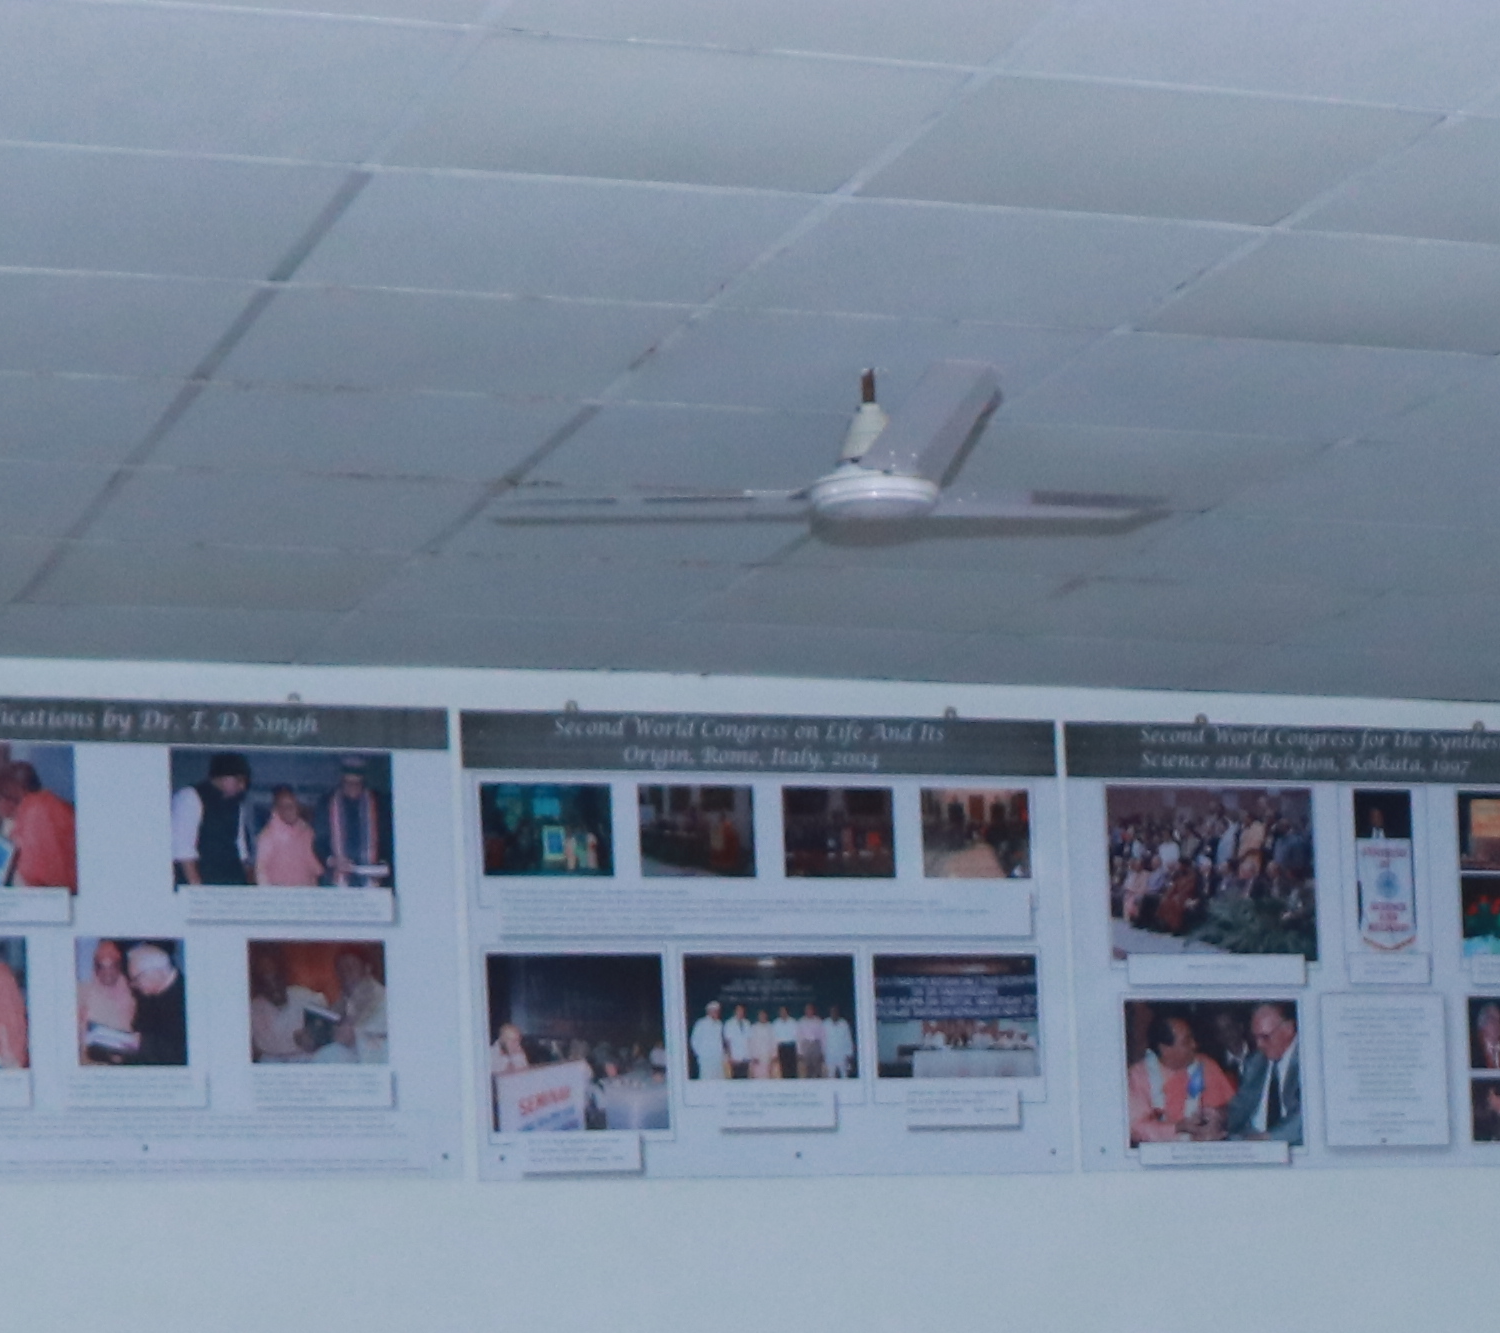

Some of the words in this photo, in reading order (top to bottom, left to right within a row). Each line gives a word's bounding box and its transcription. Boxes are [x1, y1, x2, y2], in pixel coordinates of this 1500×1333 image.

[102, 707, 132, 733] by
[141, 709, 177, 730] Dr.
[190, 711, 210, 730] T.
[218, 711, 242, 732] D.
[254, 713, 318, 739] Singh
[555, 717, 623, 738] Second
[634, 717, 695, 738] World
[701, 720, 788, 744] Congress
[795, 725, 819, 739] on
[826, 721, 863, 746] Life
[869, 722, 911, 741] And
[920, 723, 944, 741] Its
[1140, 727, 1204, 744] Second
[1216, 728, 1268, 746] World
[1275, 730, 1354, 752] Congress
[1359, 728, 1386, 750] for
[1394, 731, 1422, 748] the
[623, 746, 695, 770] Origin,
[702, 746, 764, 767] Rome,
[772, 747, 825, 770] Italy,
[830, 751, 880, 770] 2004
[1141, 751, 1209, 768] Science
[1216, 752, 1251, 769] and
[1259, 751, 1339, 774] Religion,
[1345, 755, 1424, 773] Kolkata,
[1432, 760, 1471, 778] 1997
